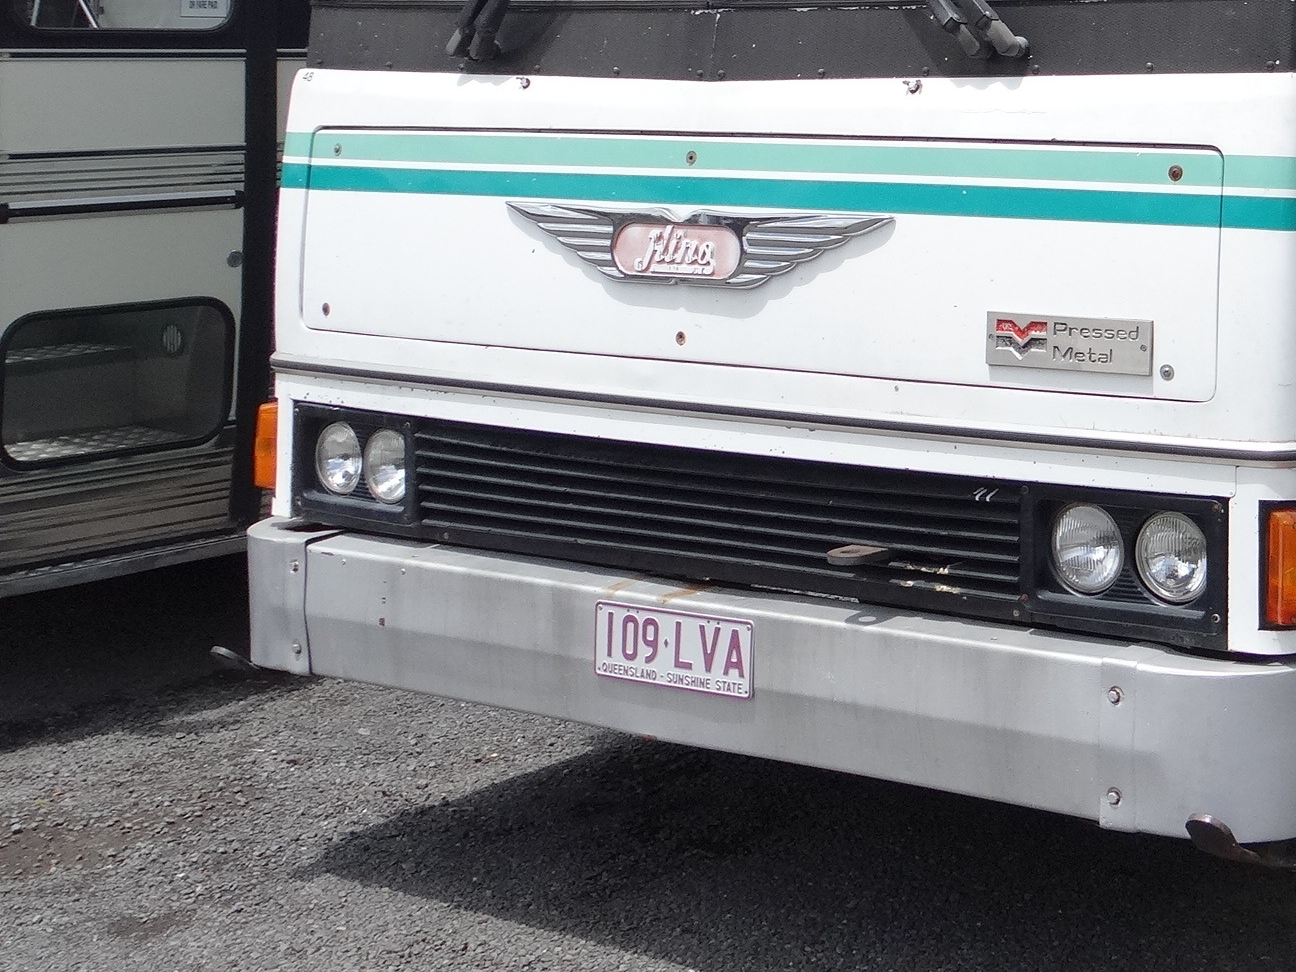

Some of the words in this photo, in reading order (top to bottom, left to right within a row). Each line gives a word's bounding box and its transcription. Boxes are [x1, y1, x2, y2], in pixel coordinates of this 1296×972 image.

[634, 224, 716, 275] Hino
[1053, 321, 1140, 341] Pressed
[1052, 345, 1113, 364] Metal
[602, 662, 657, 680] QUEENSLAND
[666, 672, 711, 689] SUNSHINE
[715, 679, 743, 695] STATE
